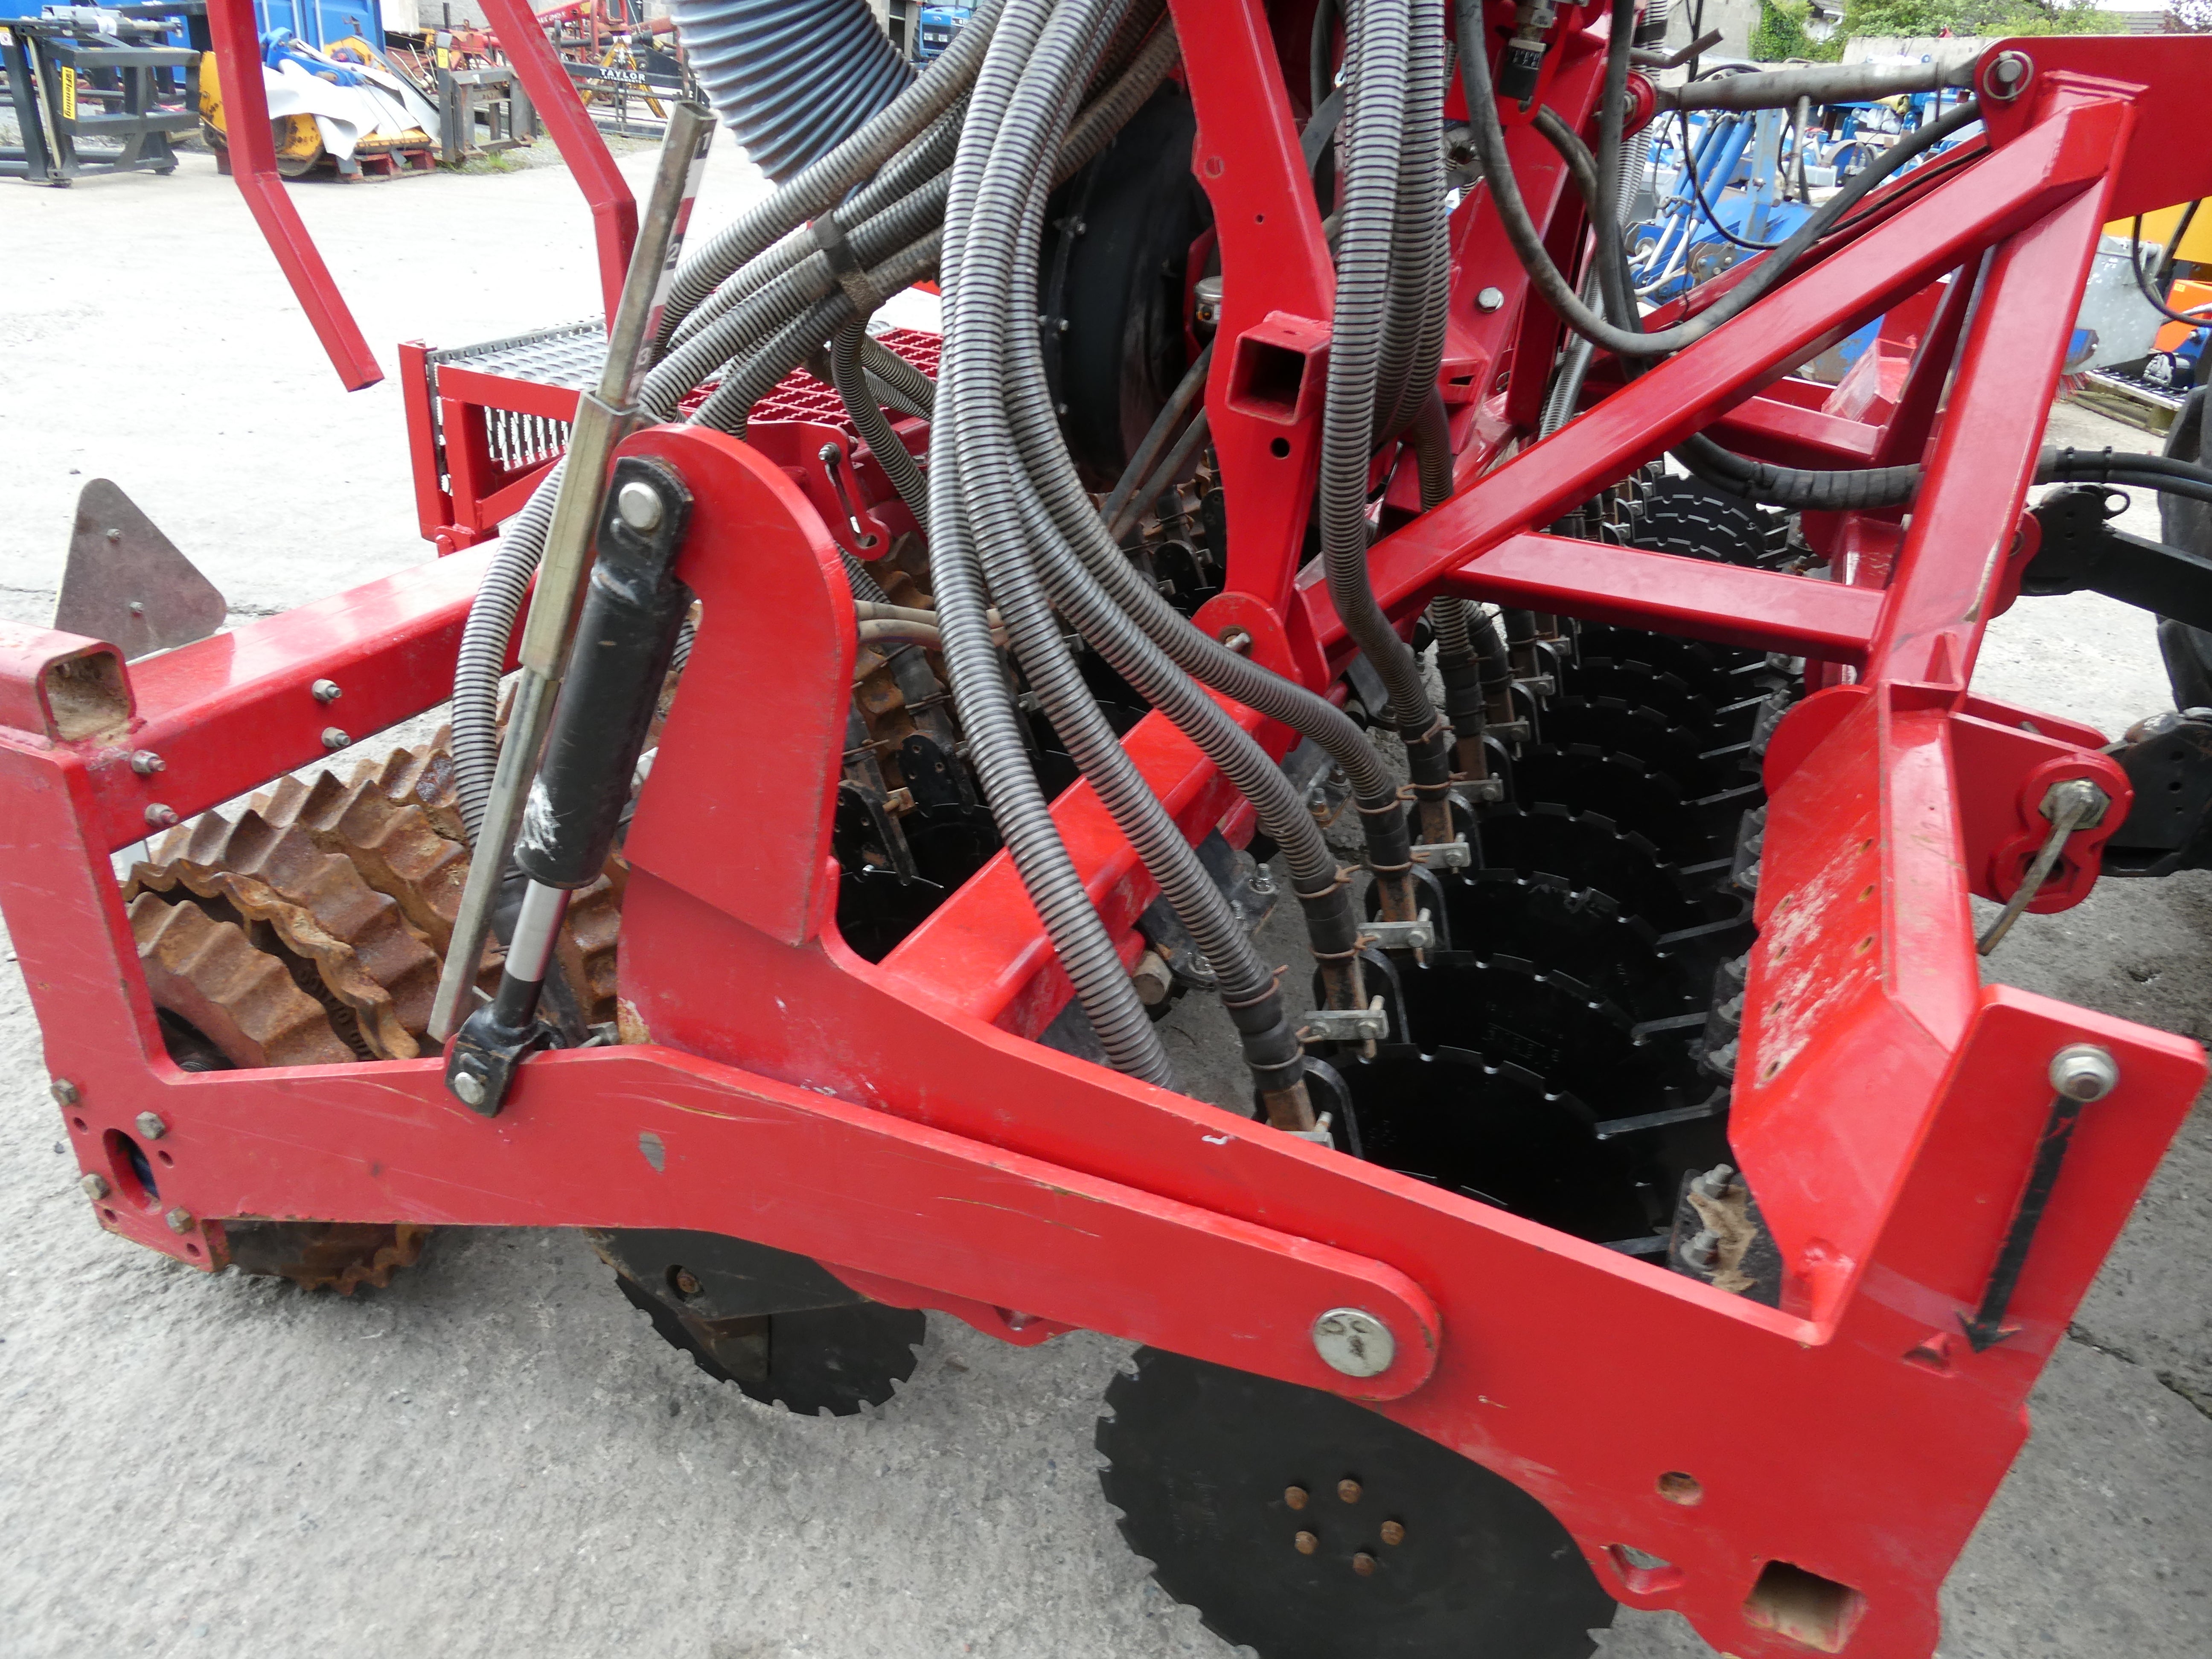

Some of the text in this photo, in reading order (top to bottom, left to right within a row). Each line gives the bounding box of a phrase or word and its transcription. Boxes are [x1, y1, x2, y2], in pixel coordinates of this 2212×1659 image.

[600, 68, 646, 81] TAYLOR
[65, 77, 73, 117] Fleming
[703, 131, 712, 151] 1
[666, 243, 681, 262] 2
[639, 347, 651, 365] 3
